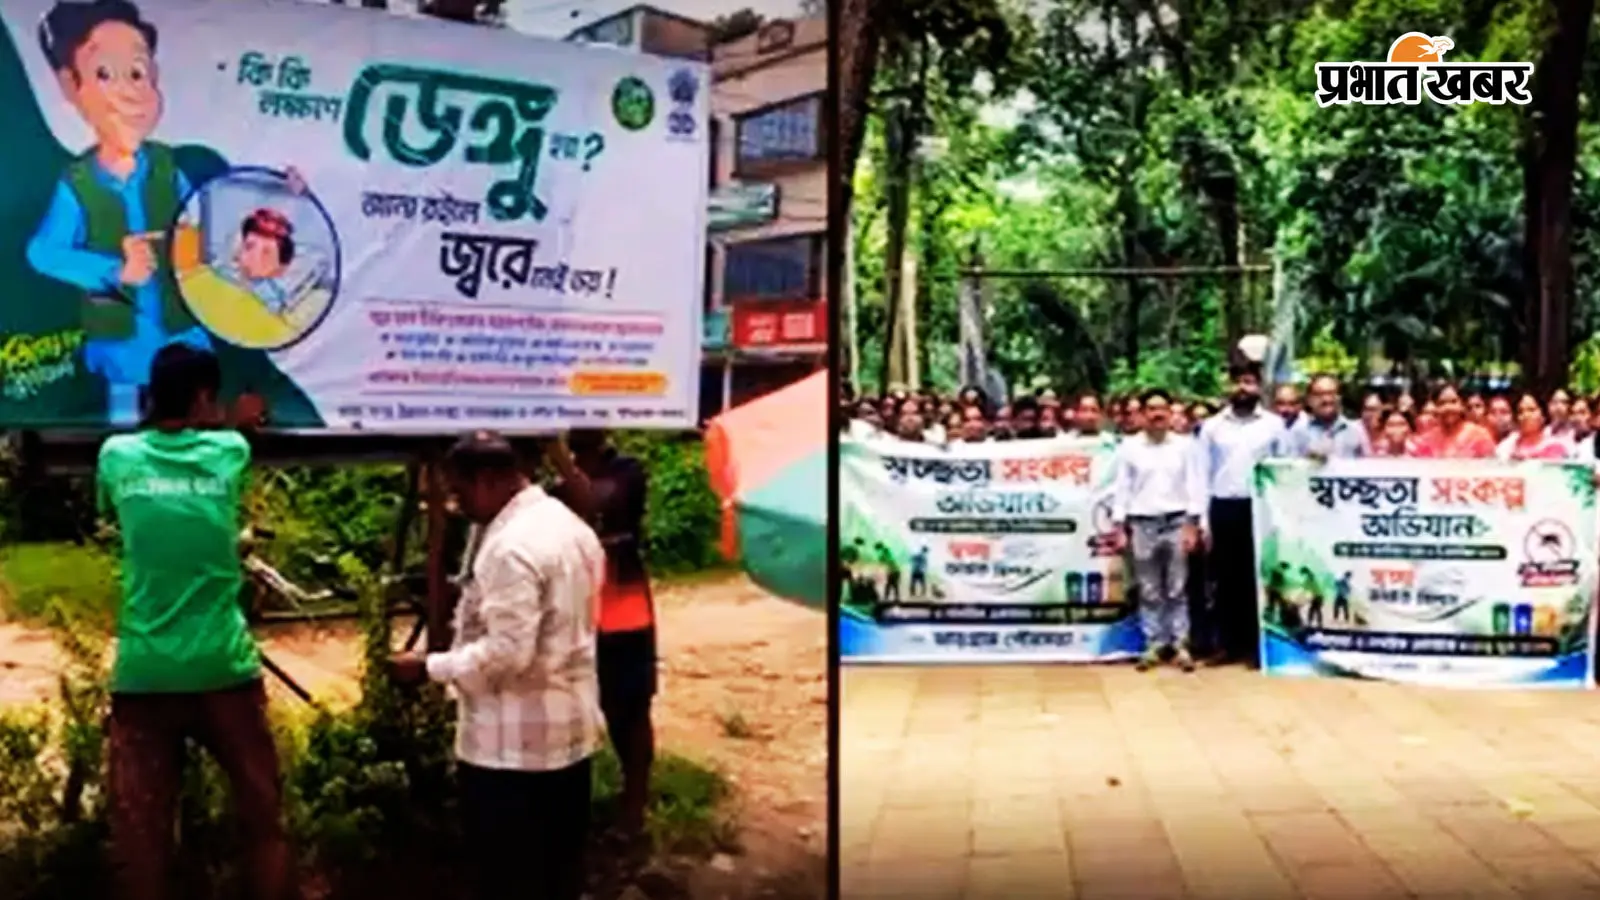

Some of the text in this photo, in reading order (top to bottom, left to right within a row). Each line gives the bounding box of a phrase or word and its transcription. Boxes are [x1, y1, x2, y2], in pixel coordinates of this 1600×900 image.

[237, 51, 311, 89] কি কি
[343, 63, 558, 223] ডেঙ্গু
[439, 232, 538, 298] জ্বরে
[1002, 455, 1093, 485] সংকল্প
[1309, 476, 1526, 510] স্বচ্ছতা সংকল্প
